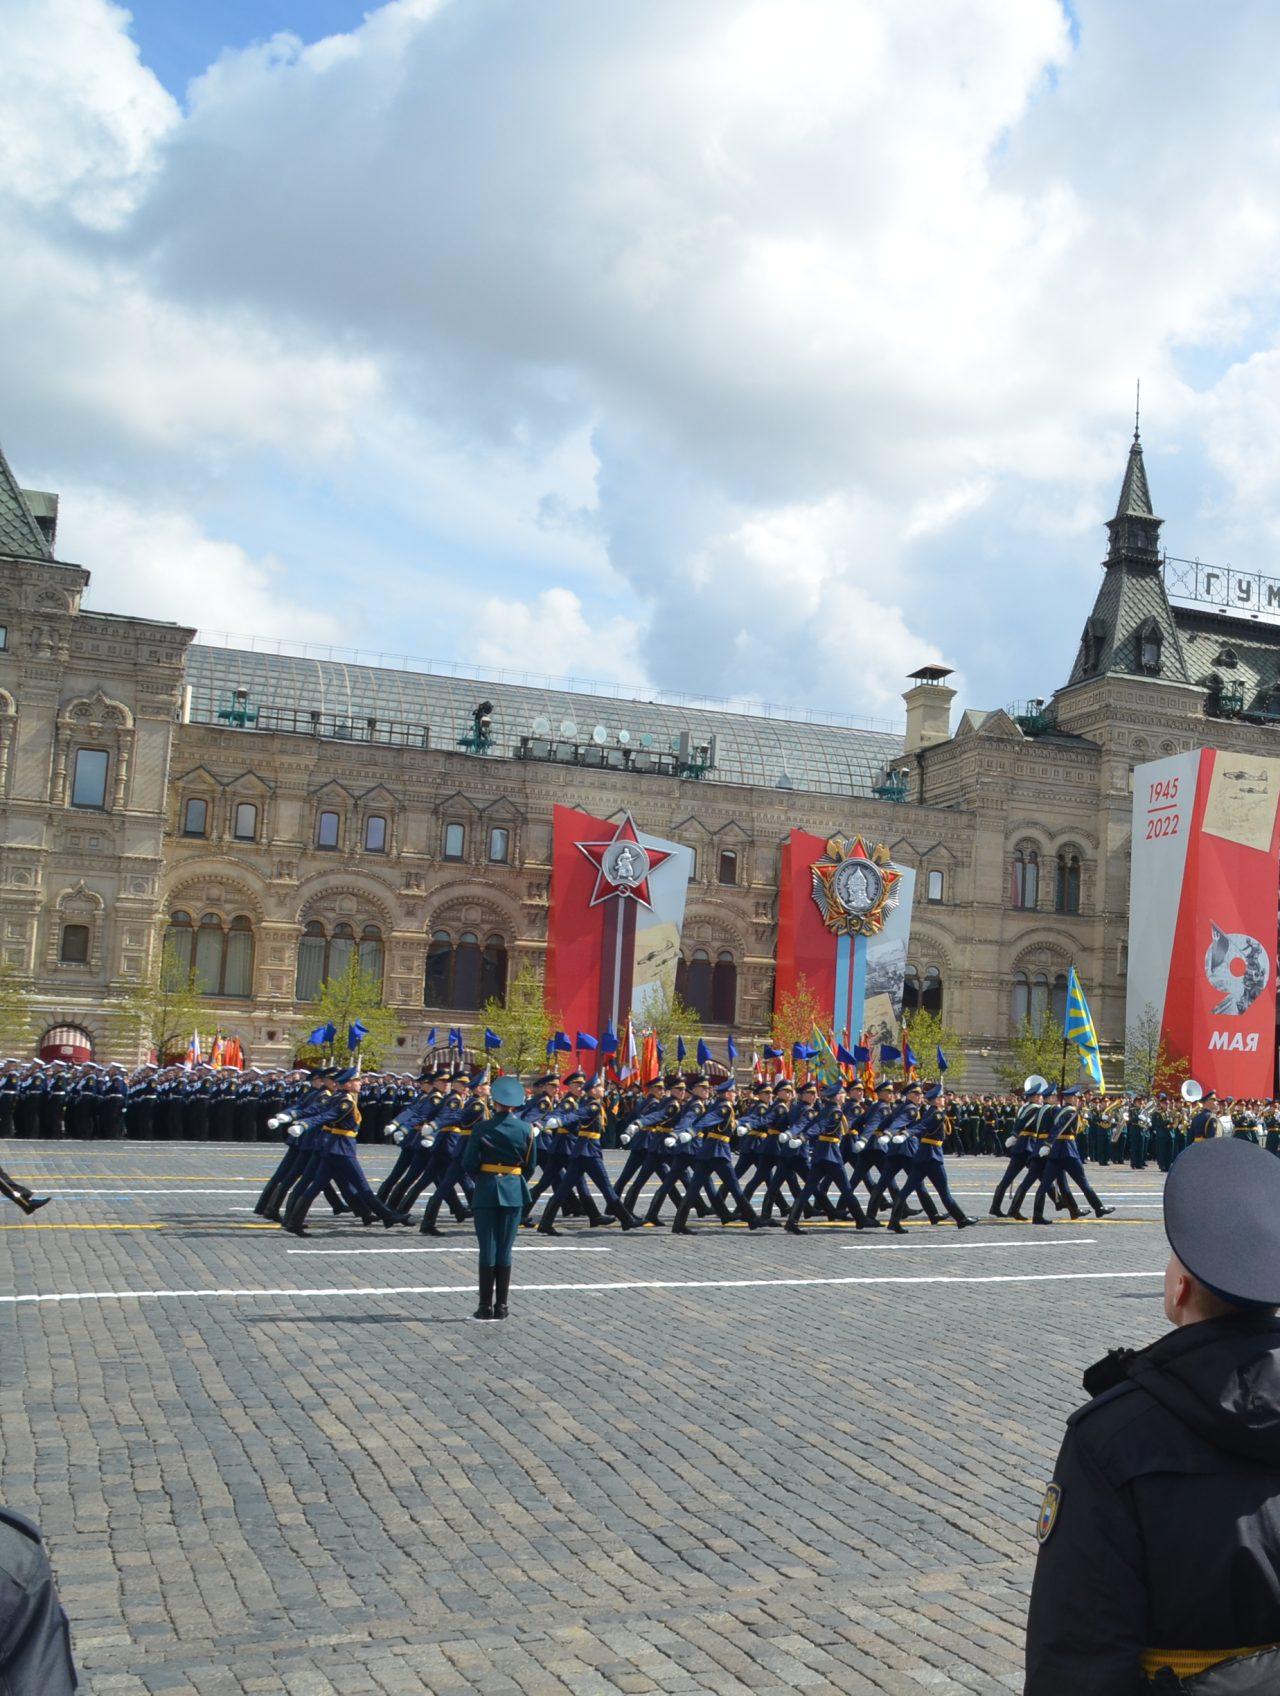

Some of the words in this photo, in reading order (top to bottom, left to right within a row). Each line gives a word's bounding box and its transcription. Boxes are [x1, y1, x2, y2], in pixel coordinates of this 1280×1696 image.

[1149, 777, 1179, 804] 1945
[1146, 813, 1180, 840] 2022
[1204, 930, 1270, 1015] 9
[1208, 1031, 1259, 1051] МАЯ
